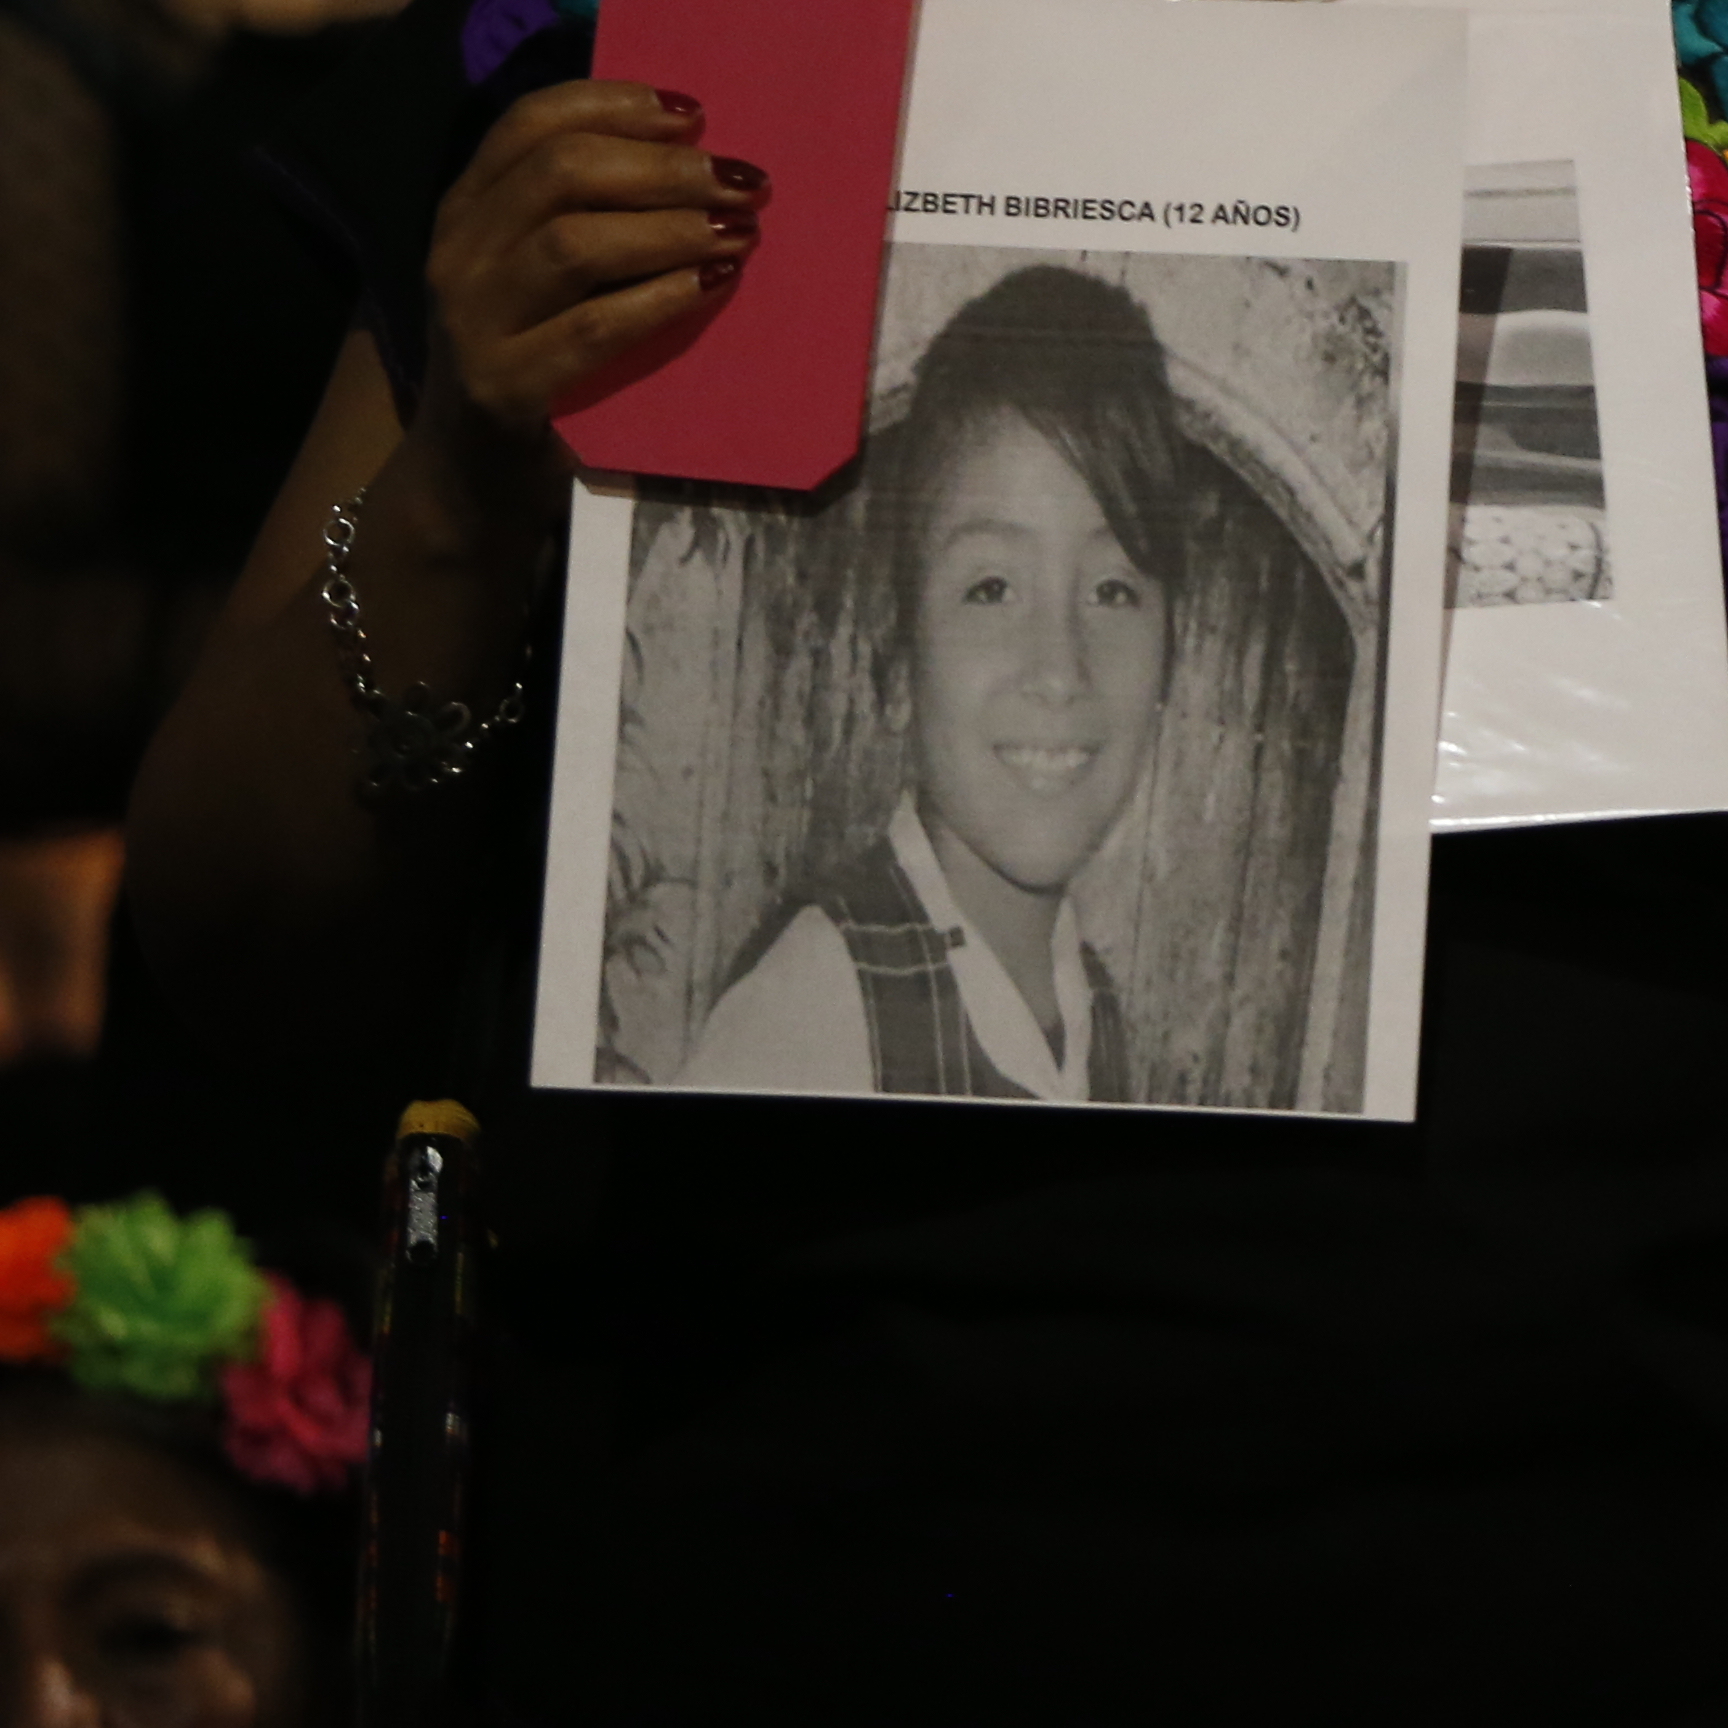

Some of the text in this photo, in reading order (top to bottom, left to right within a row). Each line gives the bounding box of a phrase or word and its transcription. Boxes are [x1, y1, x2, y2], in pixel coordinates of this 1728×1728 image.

[886, 189, 1301, 231] IZBETH BIBRIESCA (12 AÑOS)
